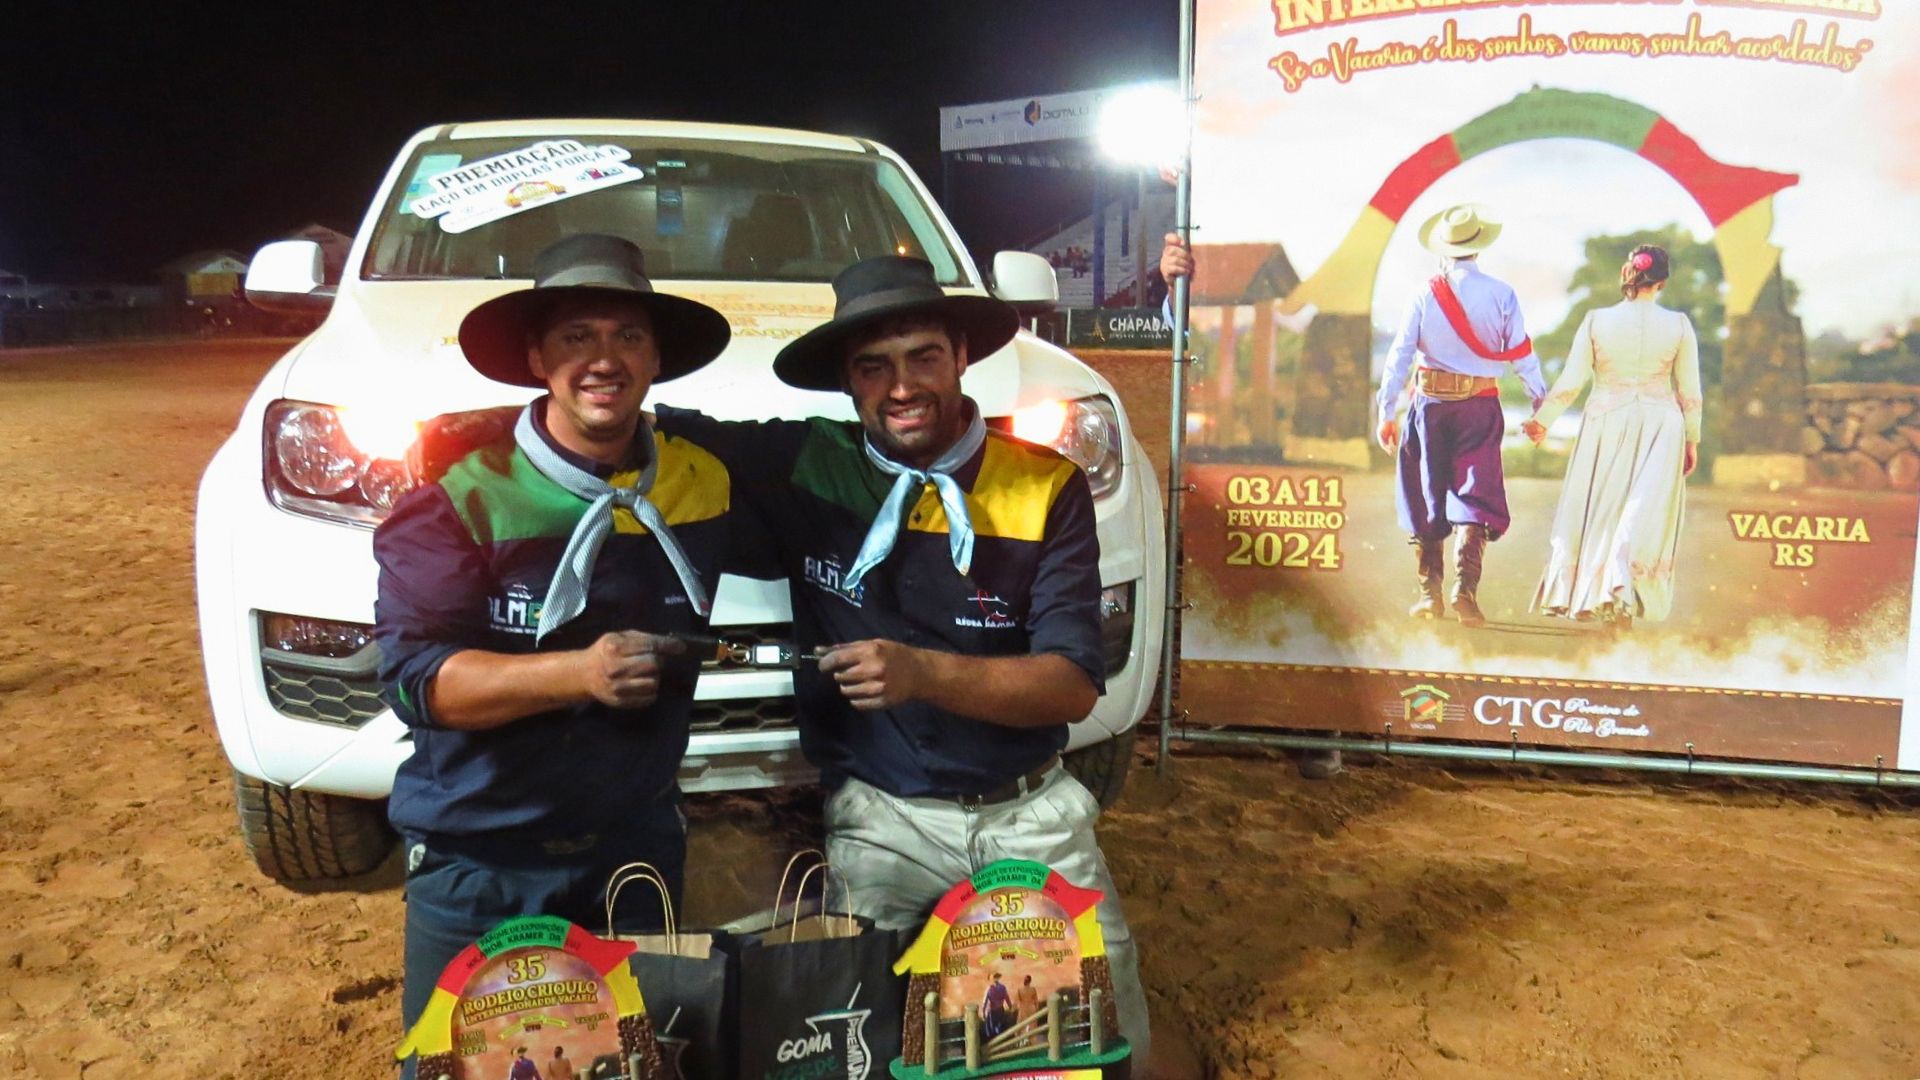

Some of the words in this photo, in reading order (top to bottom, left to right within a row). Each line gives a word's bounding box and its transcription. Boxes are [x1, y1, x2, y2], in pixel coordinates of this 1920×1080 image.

[1311, 60, 1328, 77] a
[1329, 39, 1417, 82] Vacaria
[1421, 36, 1438, 61] é
[1439, 20, 1479, 61] dos
[1569, 33, 1646, 57] vamos
[1650, 15, 1731, 57] sonhar
[419, 186, 462, 213] LAÇO
[467, 180, 490, 200] EM
[494, 161, 554, 194] DUPLAS
[557, 150, 602, 173] FORÇA
[607, 146, 622, 159] A
[437, 141, 580, 189] PREMIAÇÃO
[1228, 476, 1271, 505] 03
[1273, 479, 1298, 506] A
[1304, 478, 1343, 507] 11
[1227, 509, 1344, 529] FEVEREIRO
[1731, 513, 1871, 543] VACARIA
[1226, 531, 1341, 569] 2024
[1774, 543, 1814, 567] RS
[1473, 694, 1565, 729] CTG
[951, 919, 1005, 941] RODEIO
[1005, 917, 1067, 932] CRIOULO
[463, 986, 526, 1015] RODEIO
[526, 980, 599, 999] CRIOULO
[777, 1032, 832, 1062] GOMA
